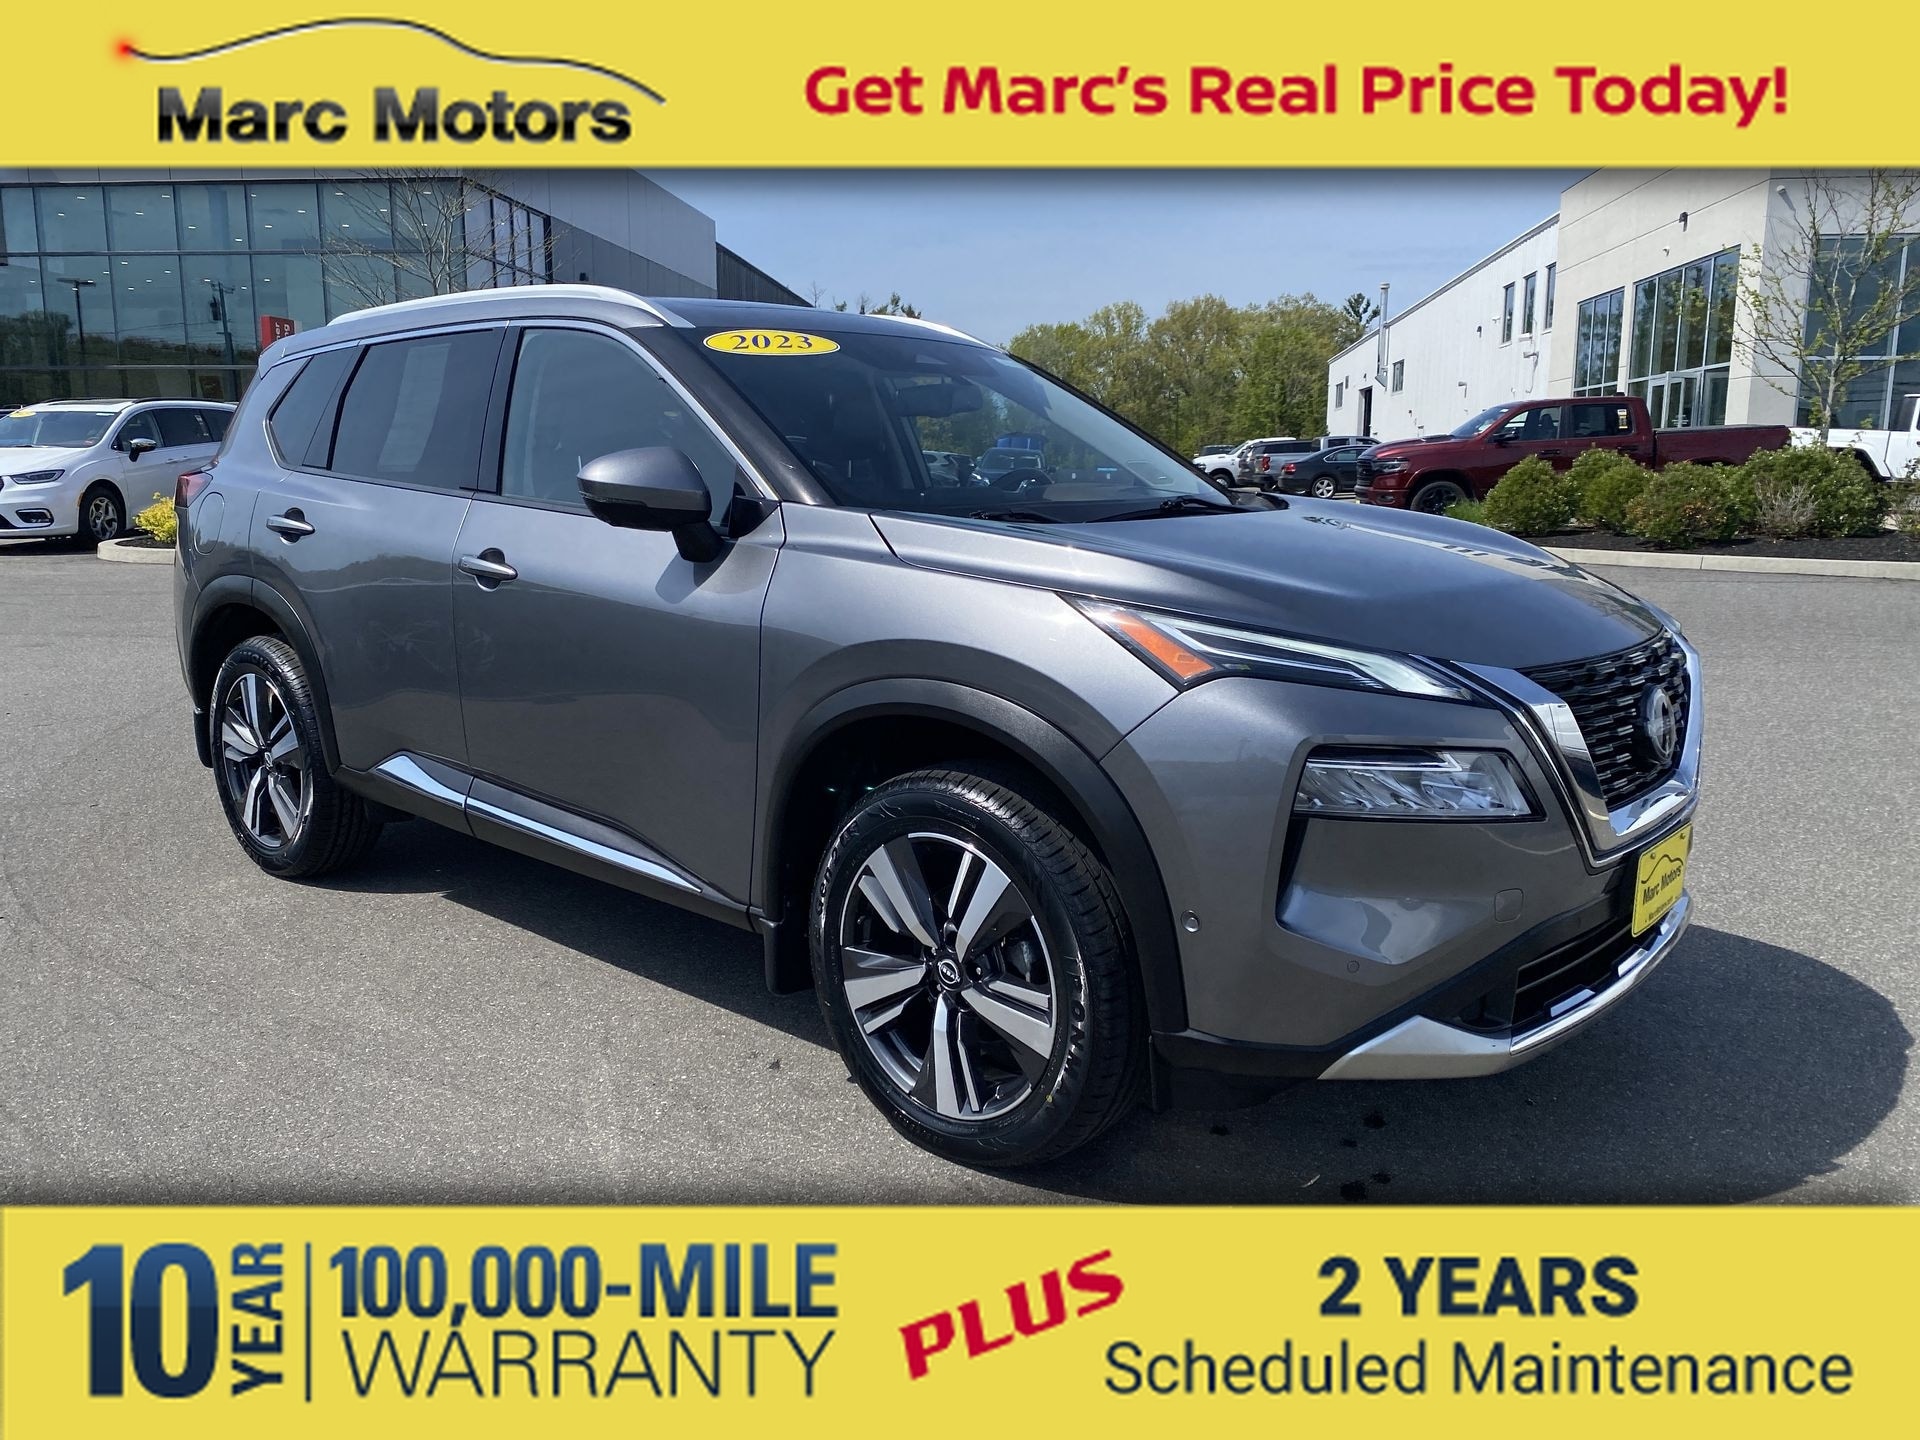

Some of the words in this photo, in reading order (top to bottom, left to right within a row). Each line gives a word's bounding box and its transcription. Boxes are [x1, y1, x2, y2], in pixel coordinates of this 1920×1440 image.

[730, 334, 813, 350] 2023
[1643, 883, 1660, 905] Marc
[1660, 866, 1681, 891] Motors
